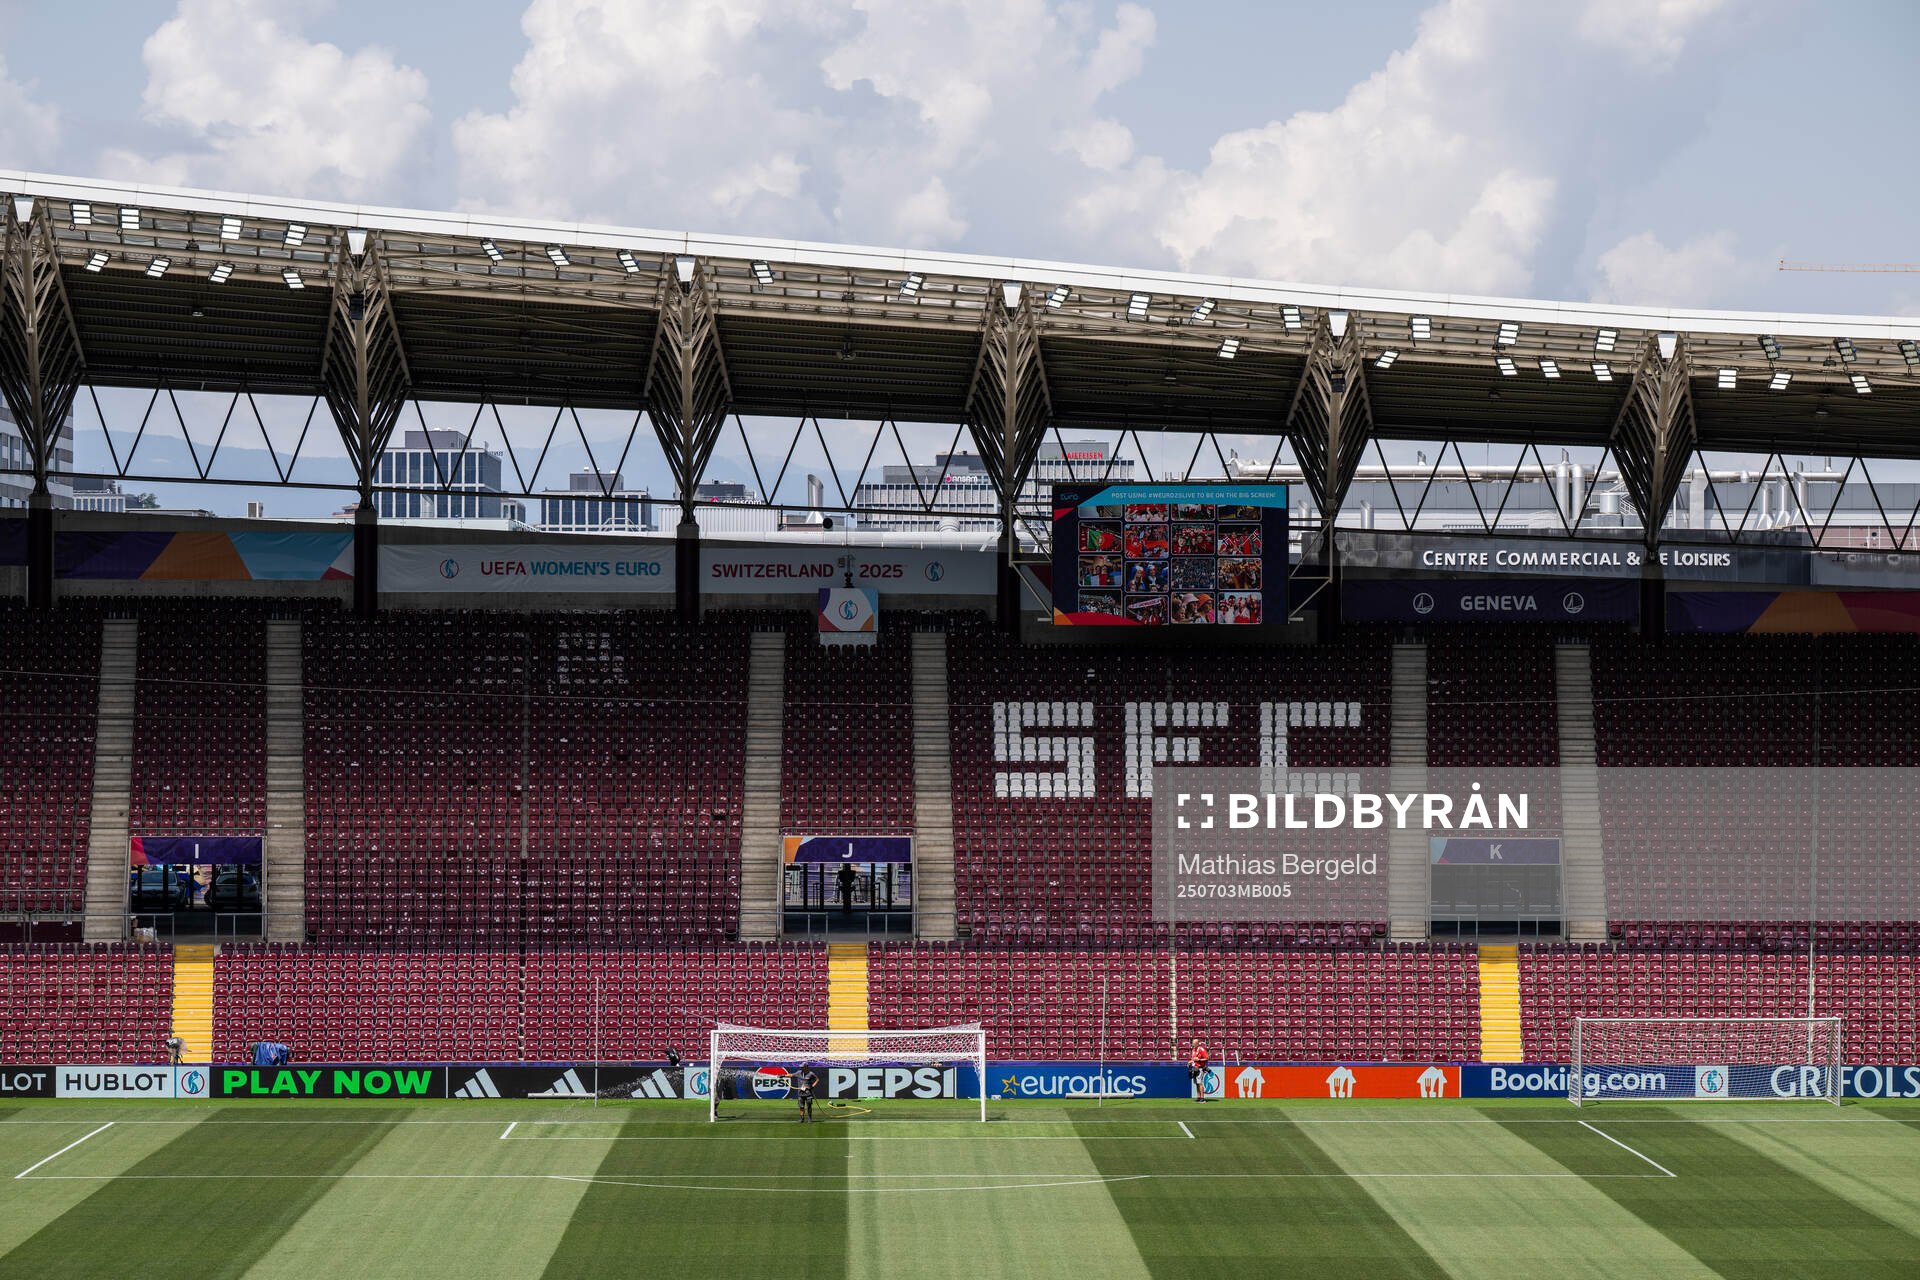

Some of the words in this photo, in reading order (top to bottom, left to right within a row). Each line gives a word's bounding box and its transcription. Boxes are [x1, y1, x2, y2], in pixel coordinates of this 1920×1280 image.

[1422, 549, 1489, 567] CENTRE
[1495, 550, 1621, 567] COMMERCIAL
[1627, 551, 1641, 566] &
[1674, 550, 1731, 567] LOISIRS
[480, 561, 527, 576] UEFA
[531, 561, 610, 576] WOMEN'S
[616, 561, 661, 576] EURO
[711, 563, 834, 579] SWITZERLAND
[859, 563, 904, 579] 2025
[1460, 595, 1537, 611] GENEVA
[842, 842, 853, 858] J
[1490, 844, 1502, 859] K
[65, 1072, 168, 1092] HUBLOT
[223, 1070, 322, 1095] PLAY
[333, 1070, 432, 1095] NOW
[754, 1078, 790, 1088] PEPSI
[828, 1068, 954, 1098] PEPSI
[1020, 1069, 1147, 1097] euronics
[1770, 1066, 1920, 1098] GRIFOLS
